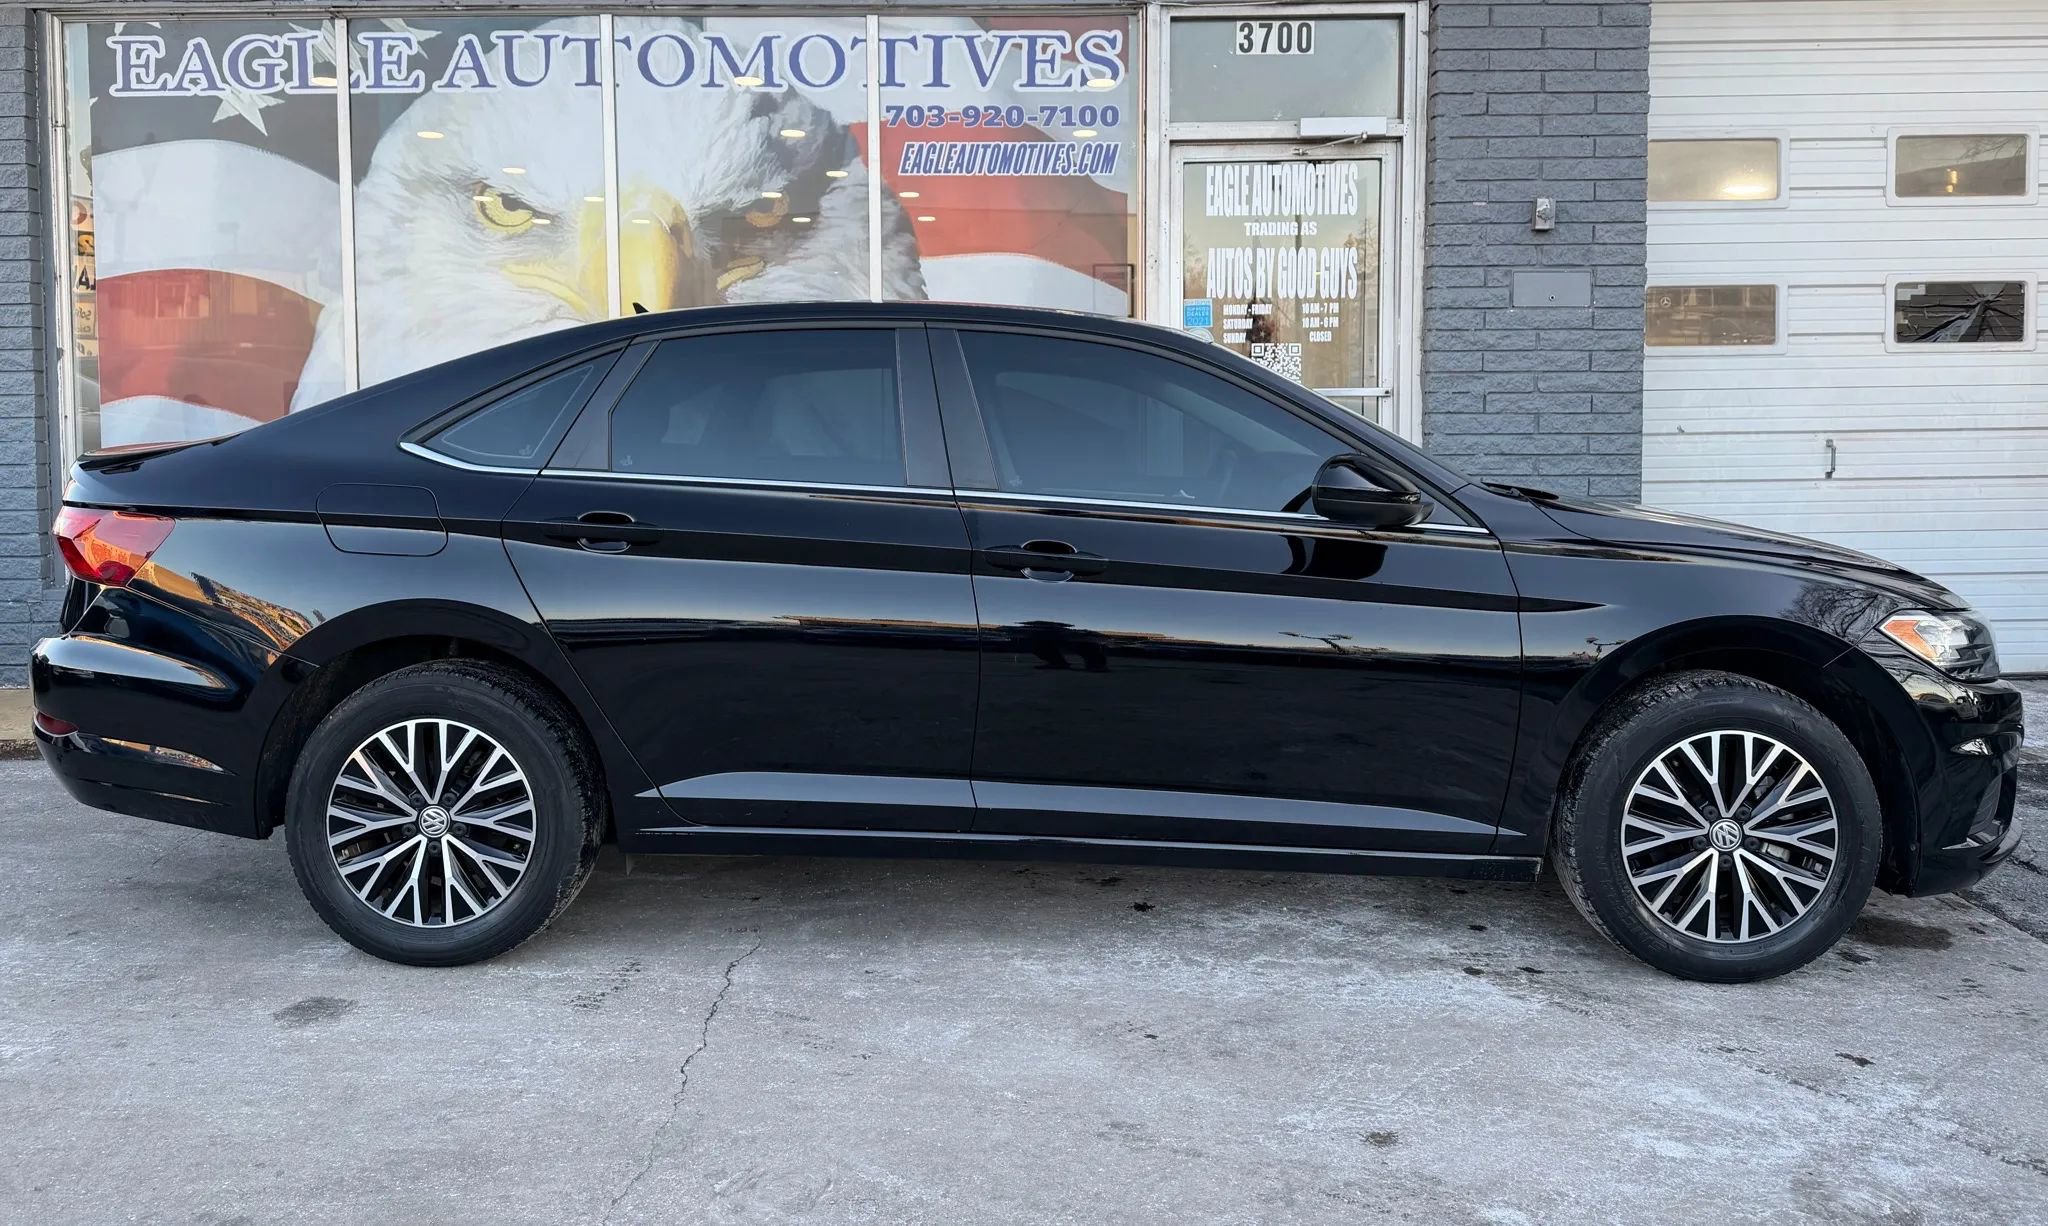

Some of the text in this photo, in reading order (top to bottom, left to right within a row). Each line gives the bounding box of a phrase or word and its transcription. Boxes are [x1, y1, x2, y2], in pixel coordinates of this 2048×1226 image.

[1238, 22, 1313, 54] 3700
[106, 29, 1124, 97] EAGLE AUTOMOTIVES
[885, 104, 1120, 129] 703-920-7100
[898, 141, 1122, 177] EAGLEAUTOMOTIVES.COM
[1206, 163, 1359, 217] EAGLE AUTOMOTIVES
[1244, 222, 1317, 236] TRADING AS
[1206, 247, 1359, 299] AUTOS BY GOOD GUYS
[1223, 304, 1248, 315] MONDAY
[1252, 303, 1272, 314] FRIDAY
[1302, 303, 1310, 314] 10
[1310, 303, 1320, 314] AM
[1323, 303, 1328, 314] 7
[1329, 303, 1339, 314] PM
[1223, 318, 1253, 329] SATURDAY
[1302, 317, 1310, 328] 10
[1310, 317, 1320, 328] AM
[1329, 317, 1339, 328] PM
[1223, 331, 1332, 343] SUNDAY CLOSED
